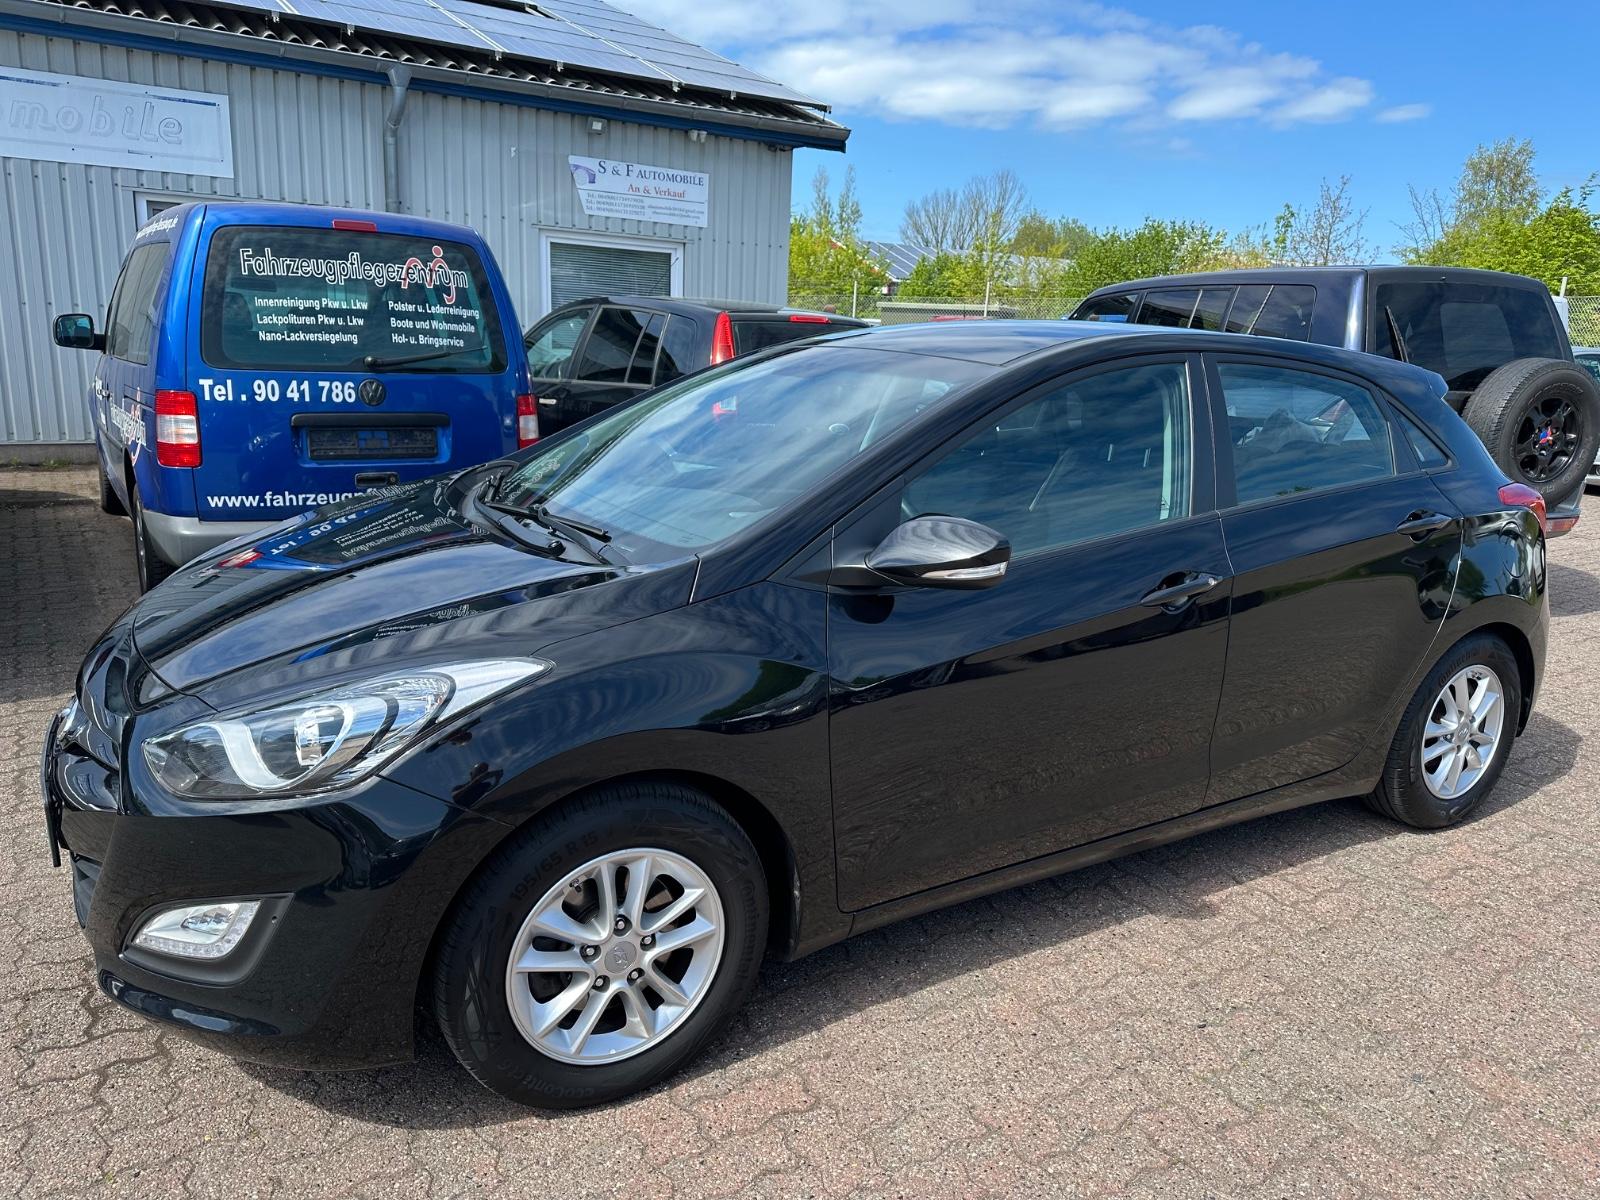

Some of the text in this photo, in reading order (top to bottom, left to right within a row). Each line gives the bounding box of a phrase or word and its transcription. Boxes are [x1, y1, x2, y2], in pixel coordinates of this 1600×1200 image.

[598, 160, 704, 187] S & F AUTOMOBILE
[627, 183, 640, 193] An
[643, 185, 652, 195] &
[654, 186, 686, 199] Verkauf
[239, 247, 469, 289] Fahrzeugpflegezentrum
[254, 296, 368, 310] Innenreinigung Pkw u. Lkw
[388, 300, 480, 319] Polster u. Lederreinigung
[256, 313, 364, 326] Lackpolituren Pkw u. Lkw
[390, 317, 475, 333] Boote und Wohnmobile
[258, 330, 358, 345] Nano-Lackversiegelung
[391, 333, 465, 348] Hol- u. Bringservice
[253, 379, 280, 402] 90
[286, 379, 310, 402] 41
[318, 380, 356, 403] 786
